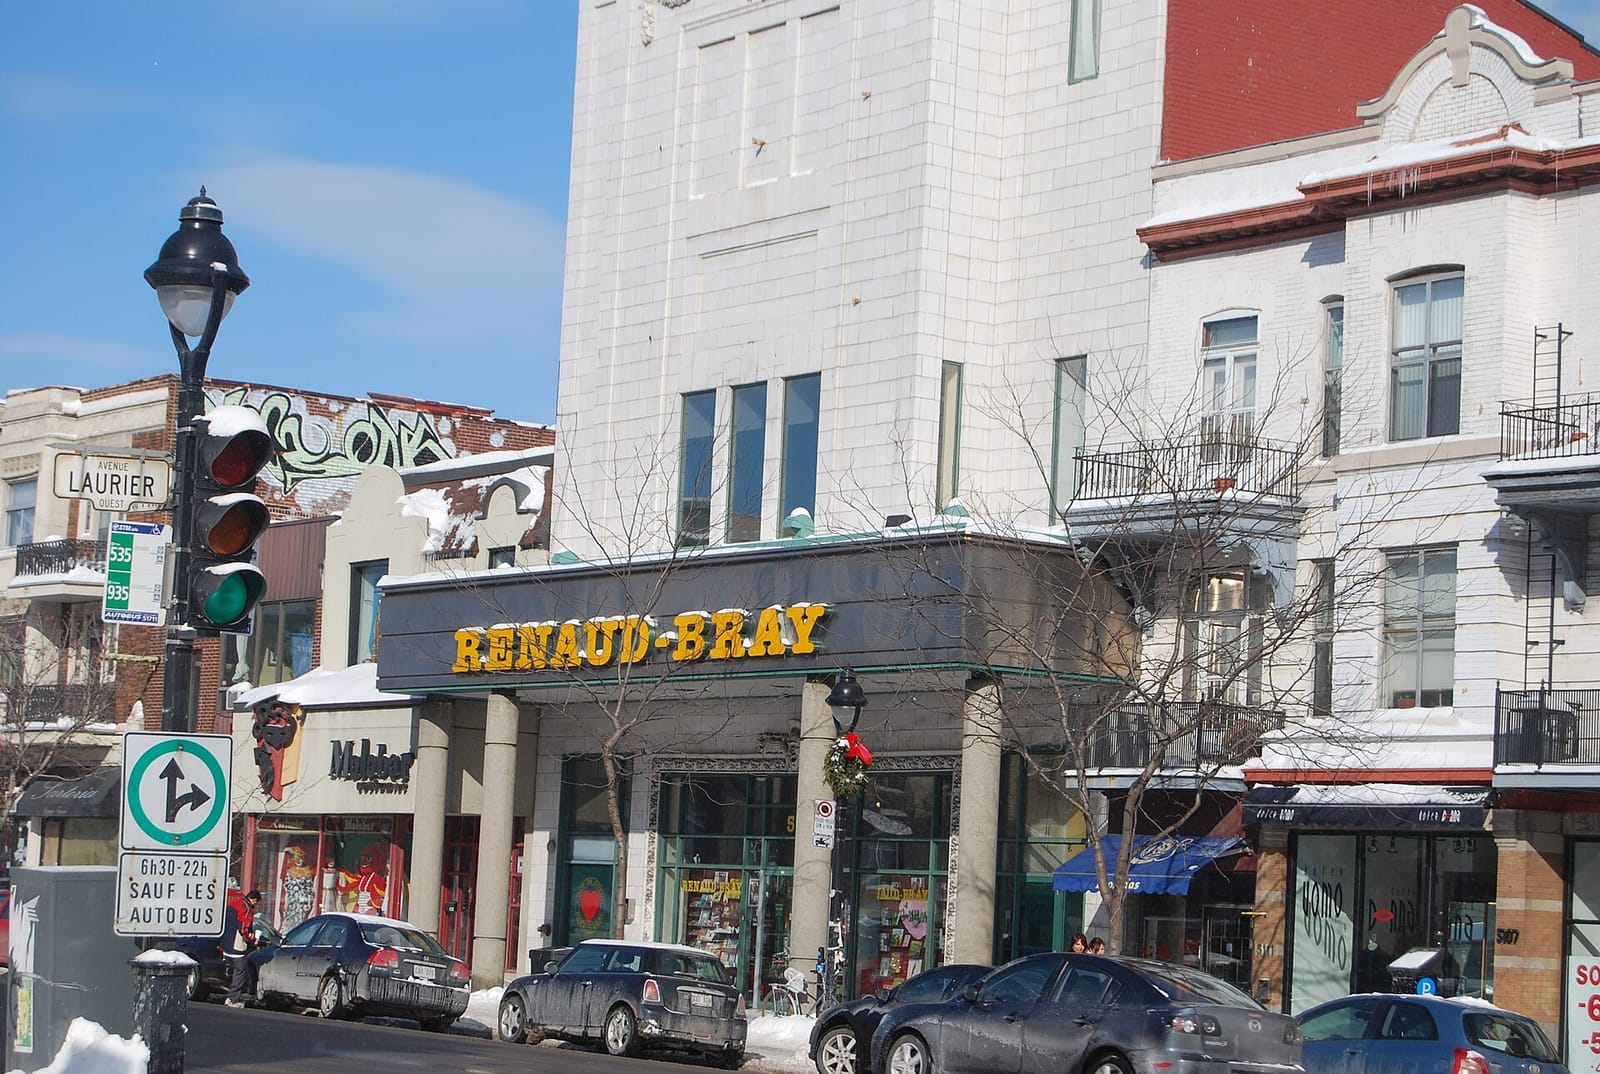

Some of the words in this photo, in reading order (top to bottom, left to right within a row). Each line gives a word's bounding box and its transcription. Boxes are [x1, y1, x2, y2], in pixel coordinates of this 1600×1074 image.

[98, 461, 128, 471] AVENUE
[69, 471, 154, 497] LAURIER
[100, 499, 124, 508] OUEST
[110, 546, 131, 562] 535
[107, 585, 129, 600] 935
[105, 612, 141, 620] AUTOBUS
[452, 605, 827, 673] RENAUD-BRAY
[328, 737, 415, 783] Malabar
[141, 859, 207, 877] 6h30-22h
[130, 882, 175, 899] SAUF
[186, 883, 215, 900] LES
[682, 879, 742, 893] RENAUD-BRAY
[130, 907, 213, 924] AUTOBUS
